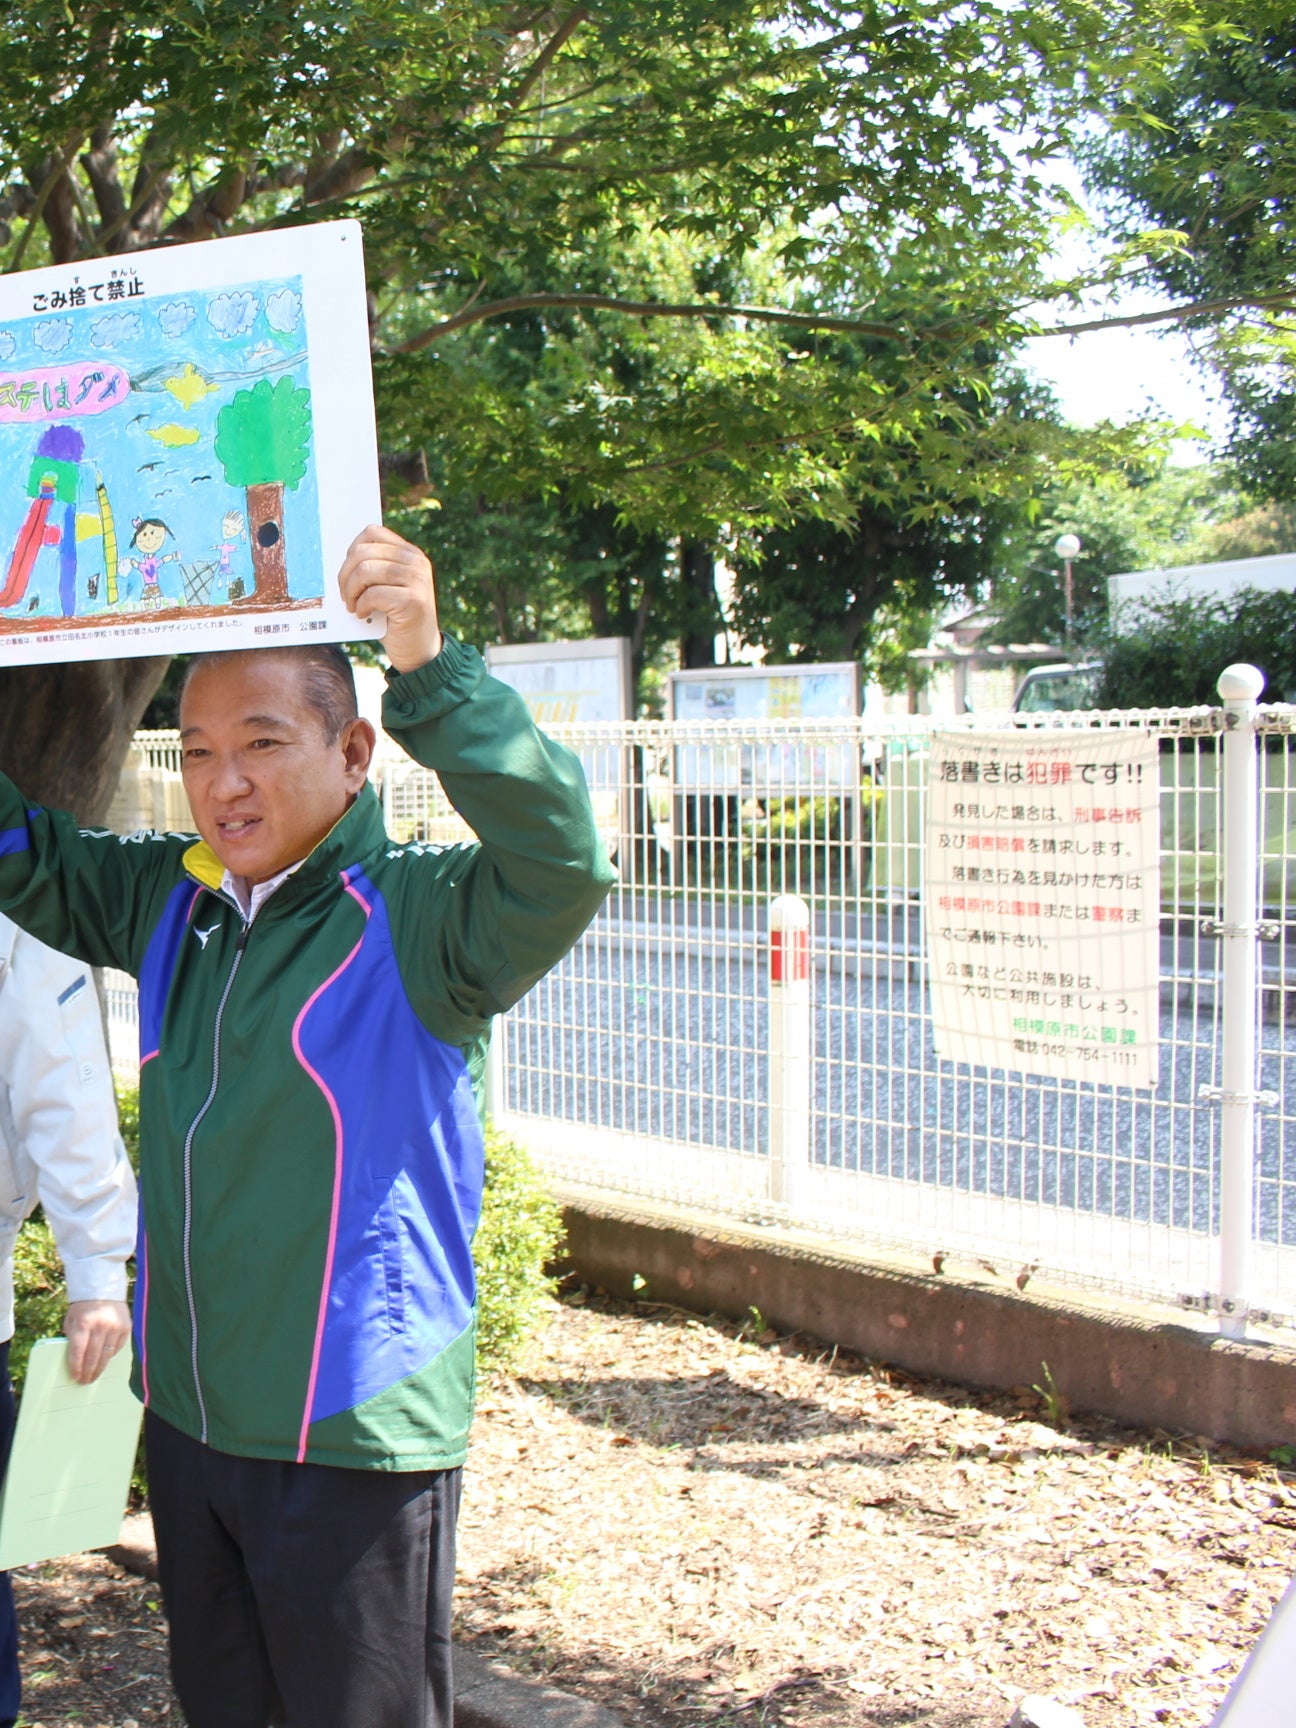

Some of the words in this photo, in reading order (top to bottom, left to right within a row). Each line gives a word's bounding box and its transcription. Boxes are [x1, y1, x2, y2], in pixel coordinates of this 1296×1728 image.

[32, 276, 145, 312] ごみ捨て禁止
[254, 623, 290, 636] 相模原市
[299, 620, 327, 632] 公園課
